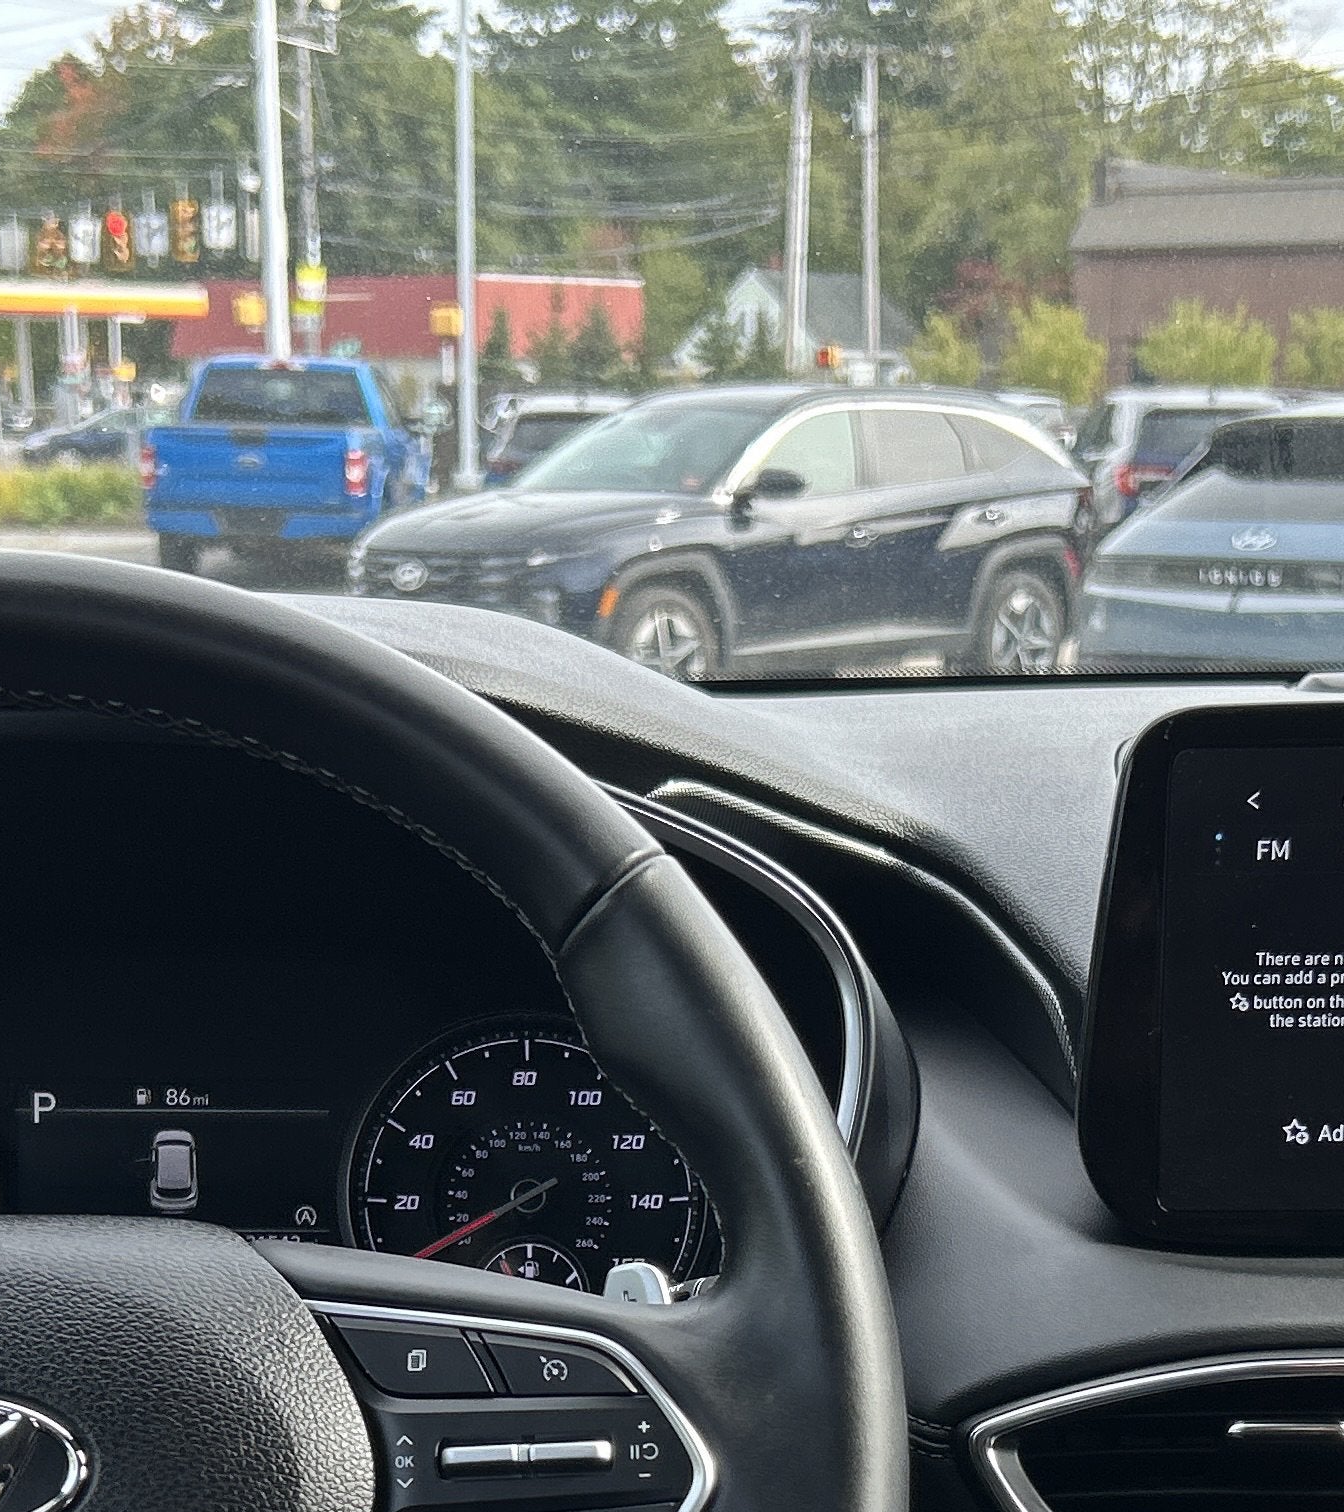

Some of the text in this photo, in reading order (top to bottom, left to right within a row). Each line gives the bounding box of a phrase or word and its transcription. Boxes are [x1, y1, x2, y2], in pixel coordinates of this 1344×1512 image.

[1256, 839, 1291, 861] FM
[1256, 952, 1300, 967] There
[1305, 955, 1330, 966] are
[1222, 971, 1249, 986] You
[1253, 974, 1280, 986] can
[1285, 971, 1313, 985] add
[1317, 973, 1326, 985] a
[1253, 994, 1302, 1009] button
[1306, 998, 1326, 1009] on
[1269, 1014, 1295, 1028] the
[512, 1071, 537, 1086] 80
[166, 1088, 209, 1106] 86 mi
[451, 1090, 476, 1106] 60
[568, 1090, 602, 1106] 100
[33, 1092, 56, 1124] P
[409, 1135, 434, 1150] 40
[509, 1131, 526, 1140] 120
[532, 1131, 550, 1140] 140
[611, 1134, 645, 1150] 120
[488, 1139, 506, 1148] 100
[554, 1140, 572, 1149] 160
[475, 1150, 488, 1159] 80
[570, 1154, 588, 1163] 180
[461, 1168, 474, 1178] 60
[582, 1172, 600, 1182] 200
[455, 1190, 468, 1200] 40
[588, 1194, 605, 1203] 220
[630, 1194, 663, 1210] 140
[394, 1195, 419, 1210] 20
[456, 1214, 469, 1223] 20
[585, 1217, 603, 1226] 240
[575, 1238, 593, 1248] 260
[394, 1455, 415, 1469] OK
